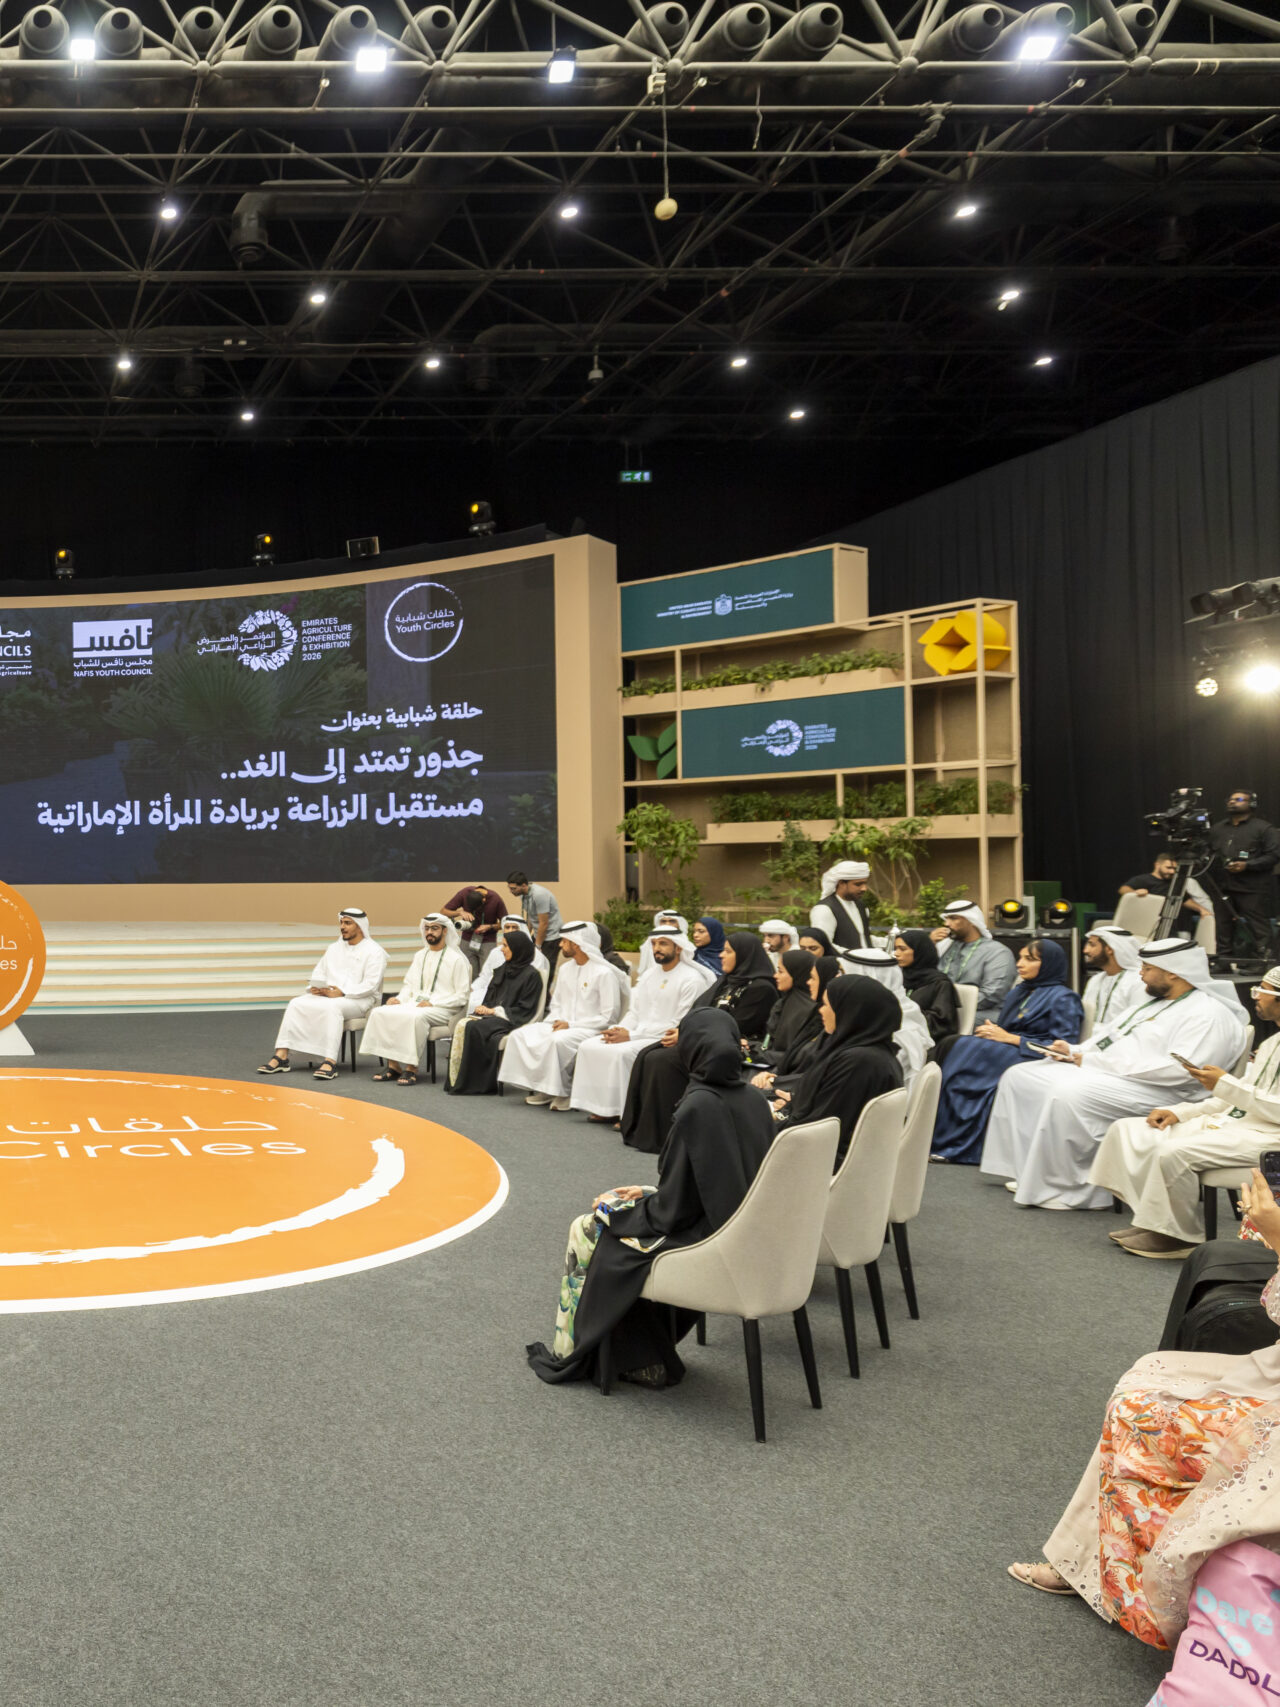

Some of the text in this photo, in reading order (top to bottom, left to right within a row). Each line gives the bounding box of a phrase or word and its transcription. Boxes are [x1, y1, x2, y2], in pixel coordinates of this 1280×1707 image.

[301, 617, 338, 628] EMIRATES
[395, 608, 455, 623] حلقات شبابية
[301, 623, 353, 636] AGRICULTURE
[395, 620, 455, 634] Youth Circles
[301, 632, 351, 644] CONFERENCE
[239, 640, 276, 652] الزراعي
[309, 640, 350, 651] EXHIBITION
[73, 657, 153, 670] مجلس نافس للشباب
[302, 652, 322, 662] 2026
[95, 669, 120, 677] YOUTH
[120, 668, 153, 676] COUNCIL
[320, 702, 483, 732] حلقة شبابية بعنوان
[290, 747, 347, 784] إلى
[353, 746, 412, 773] تمتد
[413, 740, 484, 778] جذور
[37, 792, 484, 835] مستقبل الزراعة بريادة المرأة الإماراتية
[6, 1116, 279, 1134] حلقات
[1196, 1586, 1274, 1636] Dare
